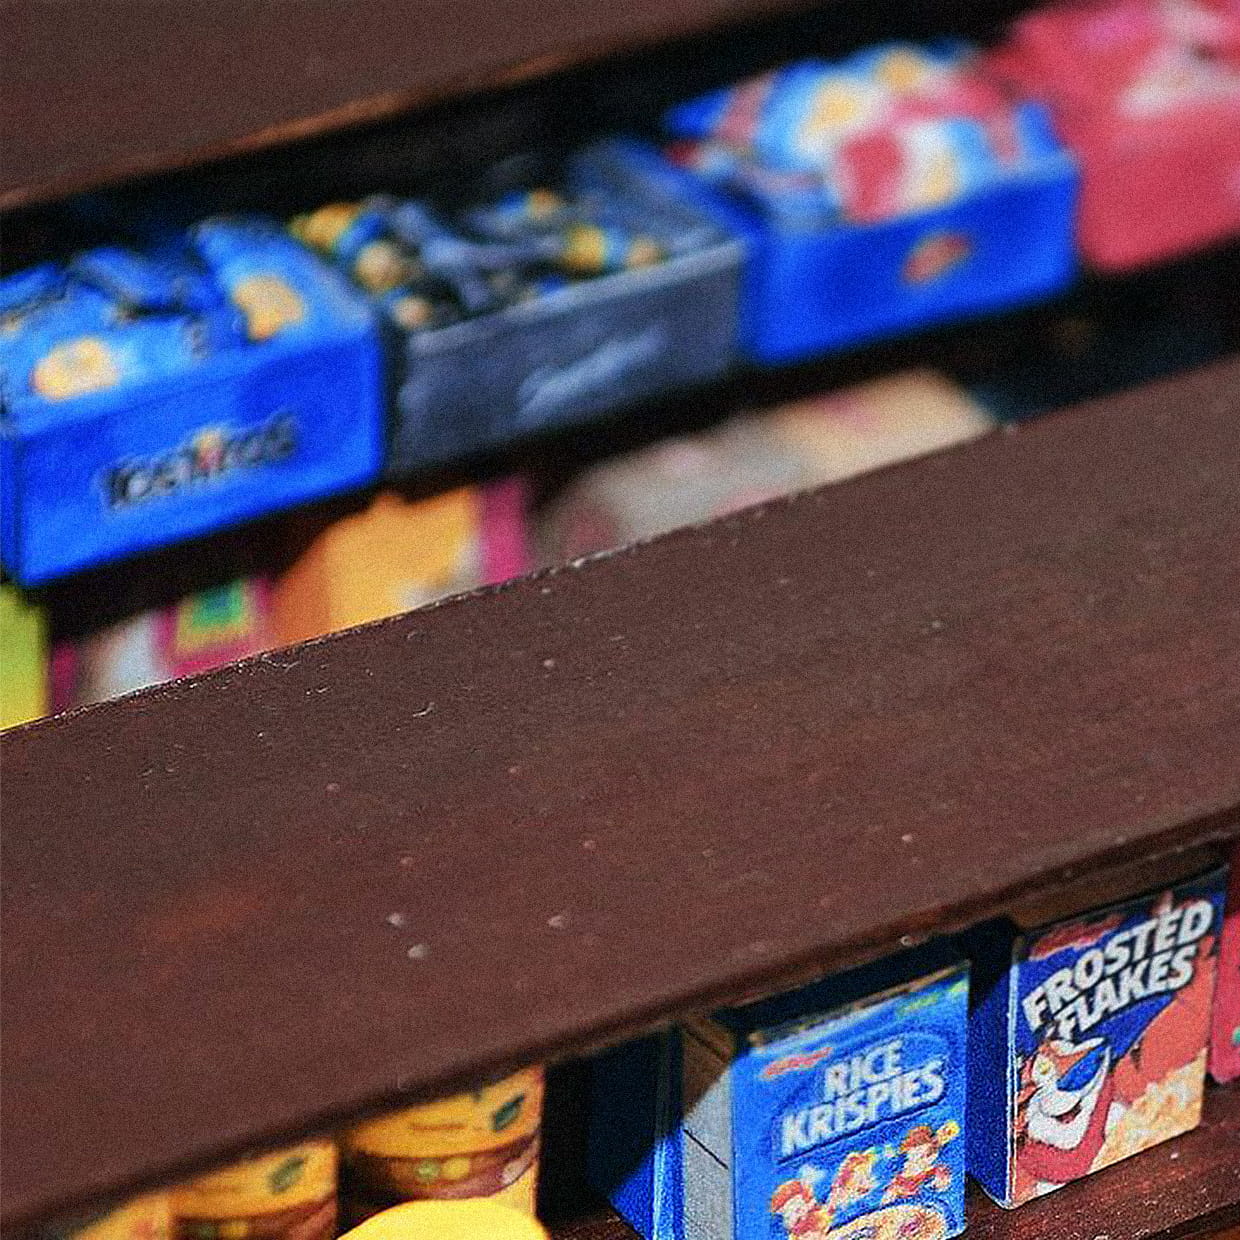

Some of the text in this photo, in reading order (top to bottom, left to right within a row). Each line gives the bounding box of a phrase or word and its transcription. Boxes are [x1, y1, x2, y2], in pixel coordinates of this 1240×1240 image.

[1021, 899, 1214, 1034] FROSTED
[1053, 944, 1198, 1040] FLAKES
[781, 1058, 946, 1157] KRISPIES
[823, 1039, 904, 1101] RICE
